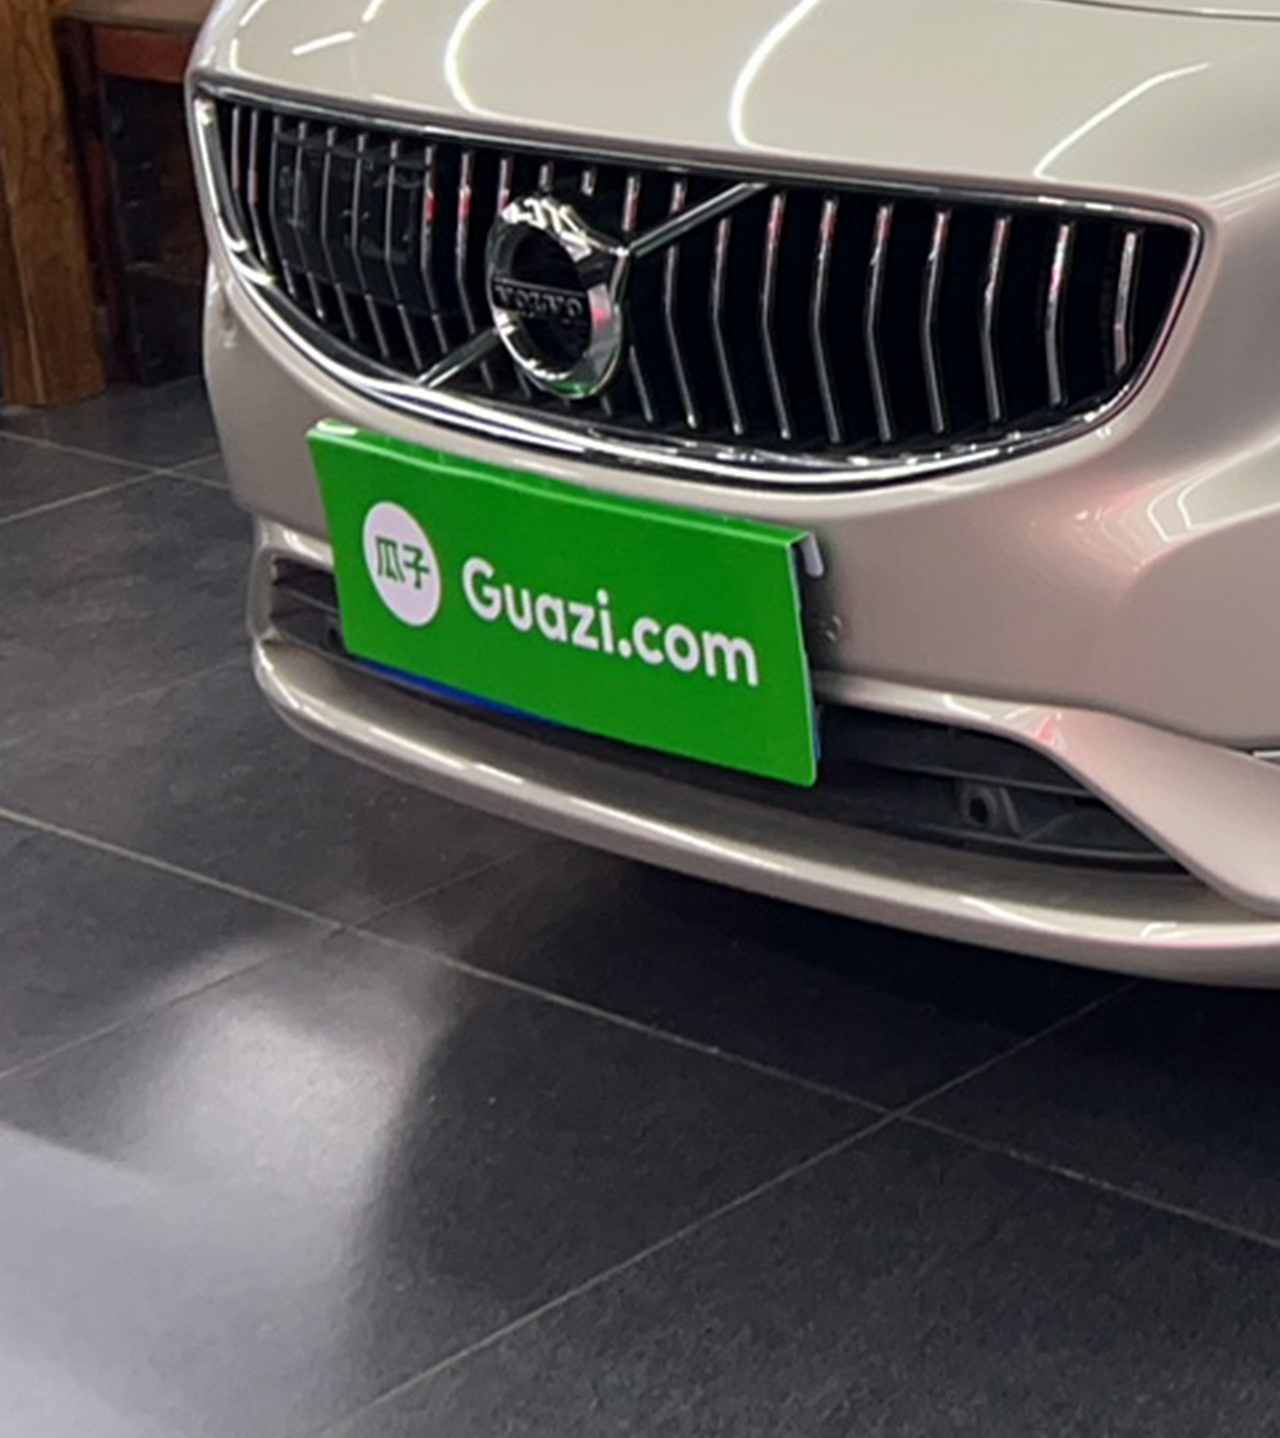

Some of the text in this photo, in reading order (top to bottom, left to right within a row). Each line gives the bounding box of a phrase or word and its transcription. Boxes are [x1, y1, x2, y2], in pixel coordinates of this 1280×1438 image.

[493, 284, 583, 317] VOLVO
[375, 535, 431, 591] 瓜子
[461, 556, 760, 687] Guazi.com
